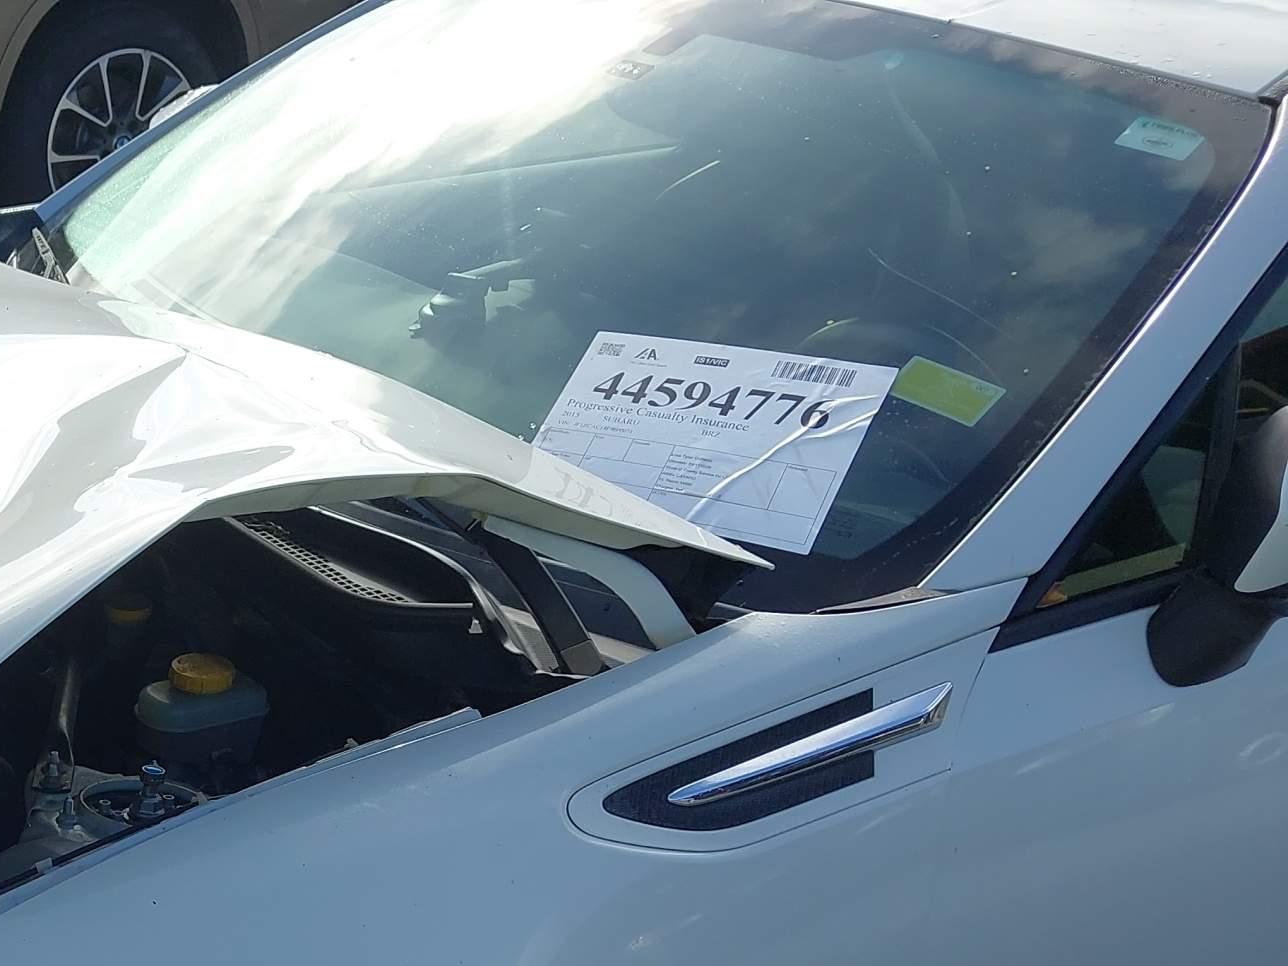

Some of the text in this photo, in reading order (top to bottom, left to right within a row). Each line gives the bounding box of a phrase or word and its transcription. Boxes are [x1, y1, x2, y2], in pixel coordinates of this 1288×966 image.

[567, 398, 751, 432] Progressive Casualty Insurance
[593, 372, 830, 429] 44594776
